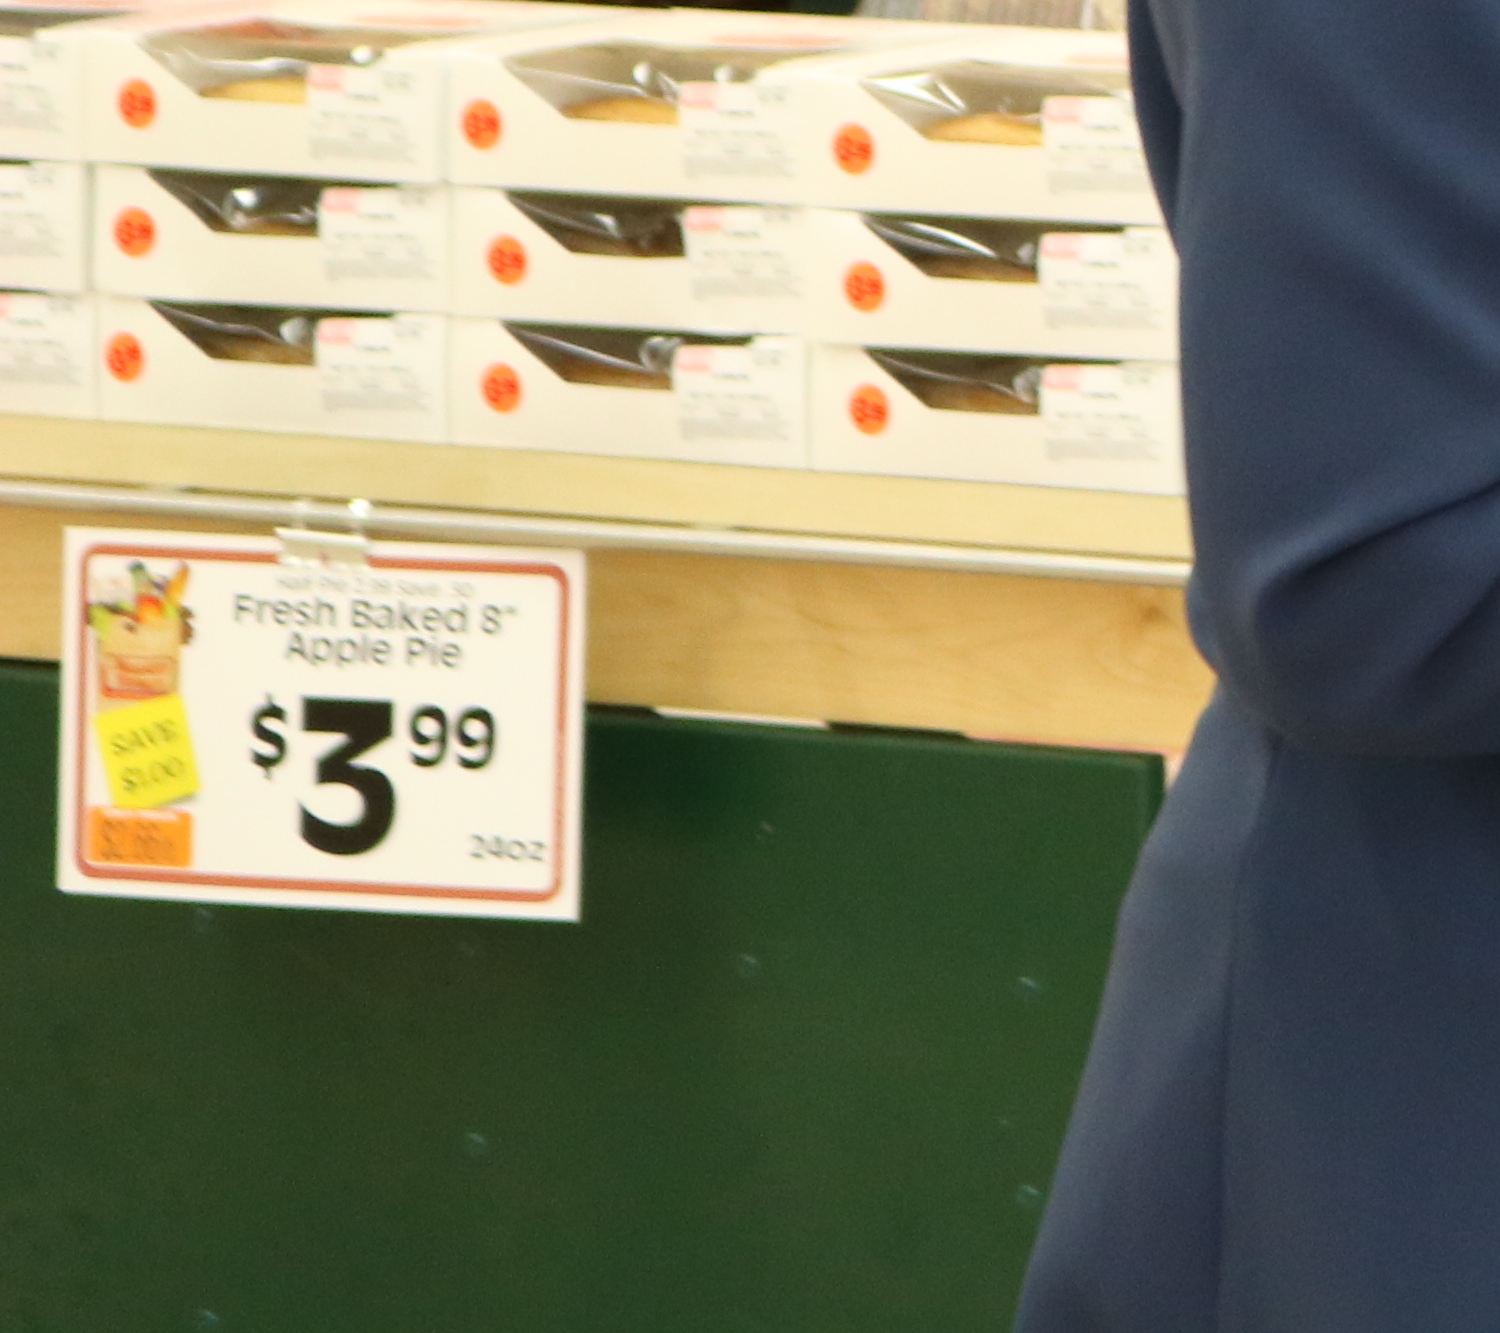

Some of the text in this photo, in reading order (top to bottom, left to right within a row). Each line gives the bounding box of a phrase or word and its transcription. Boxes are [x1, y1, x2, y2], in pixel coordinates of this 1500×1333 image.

[235, 593, 337, 626] Fresh
[351, 598, 468, 634] Baked
[285, 631, 461, 669] Apple Pie
[469, 834, 547, 863] 24oz
